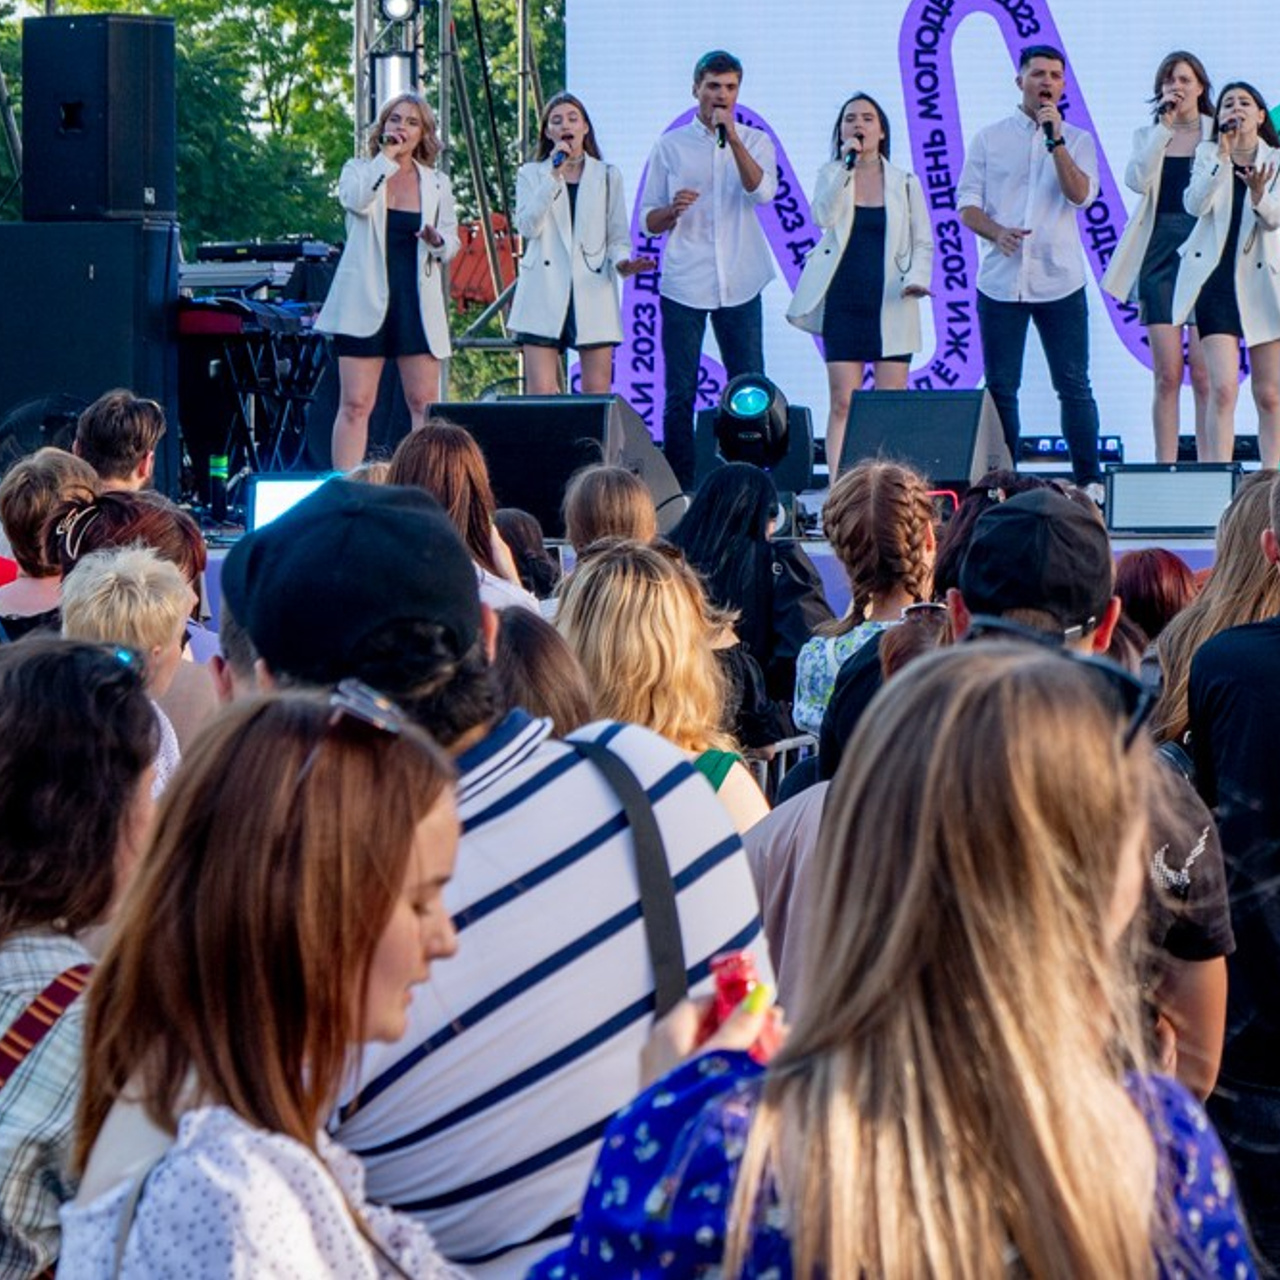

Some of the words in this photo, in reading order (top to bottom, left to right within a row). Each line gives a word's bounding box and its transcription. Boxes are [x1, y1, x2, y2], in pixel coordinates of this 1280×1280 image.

[922, 128, 958, 210] ДЕНЬ
[936, 219, 968, 290] 2023
[631, 302, 657, 374] 2023
